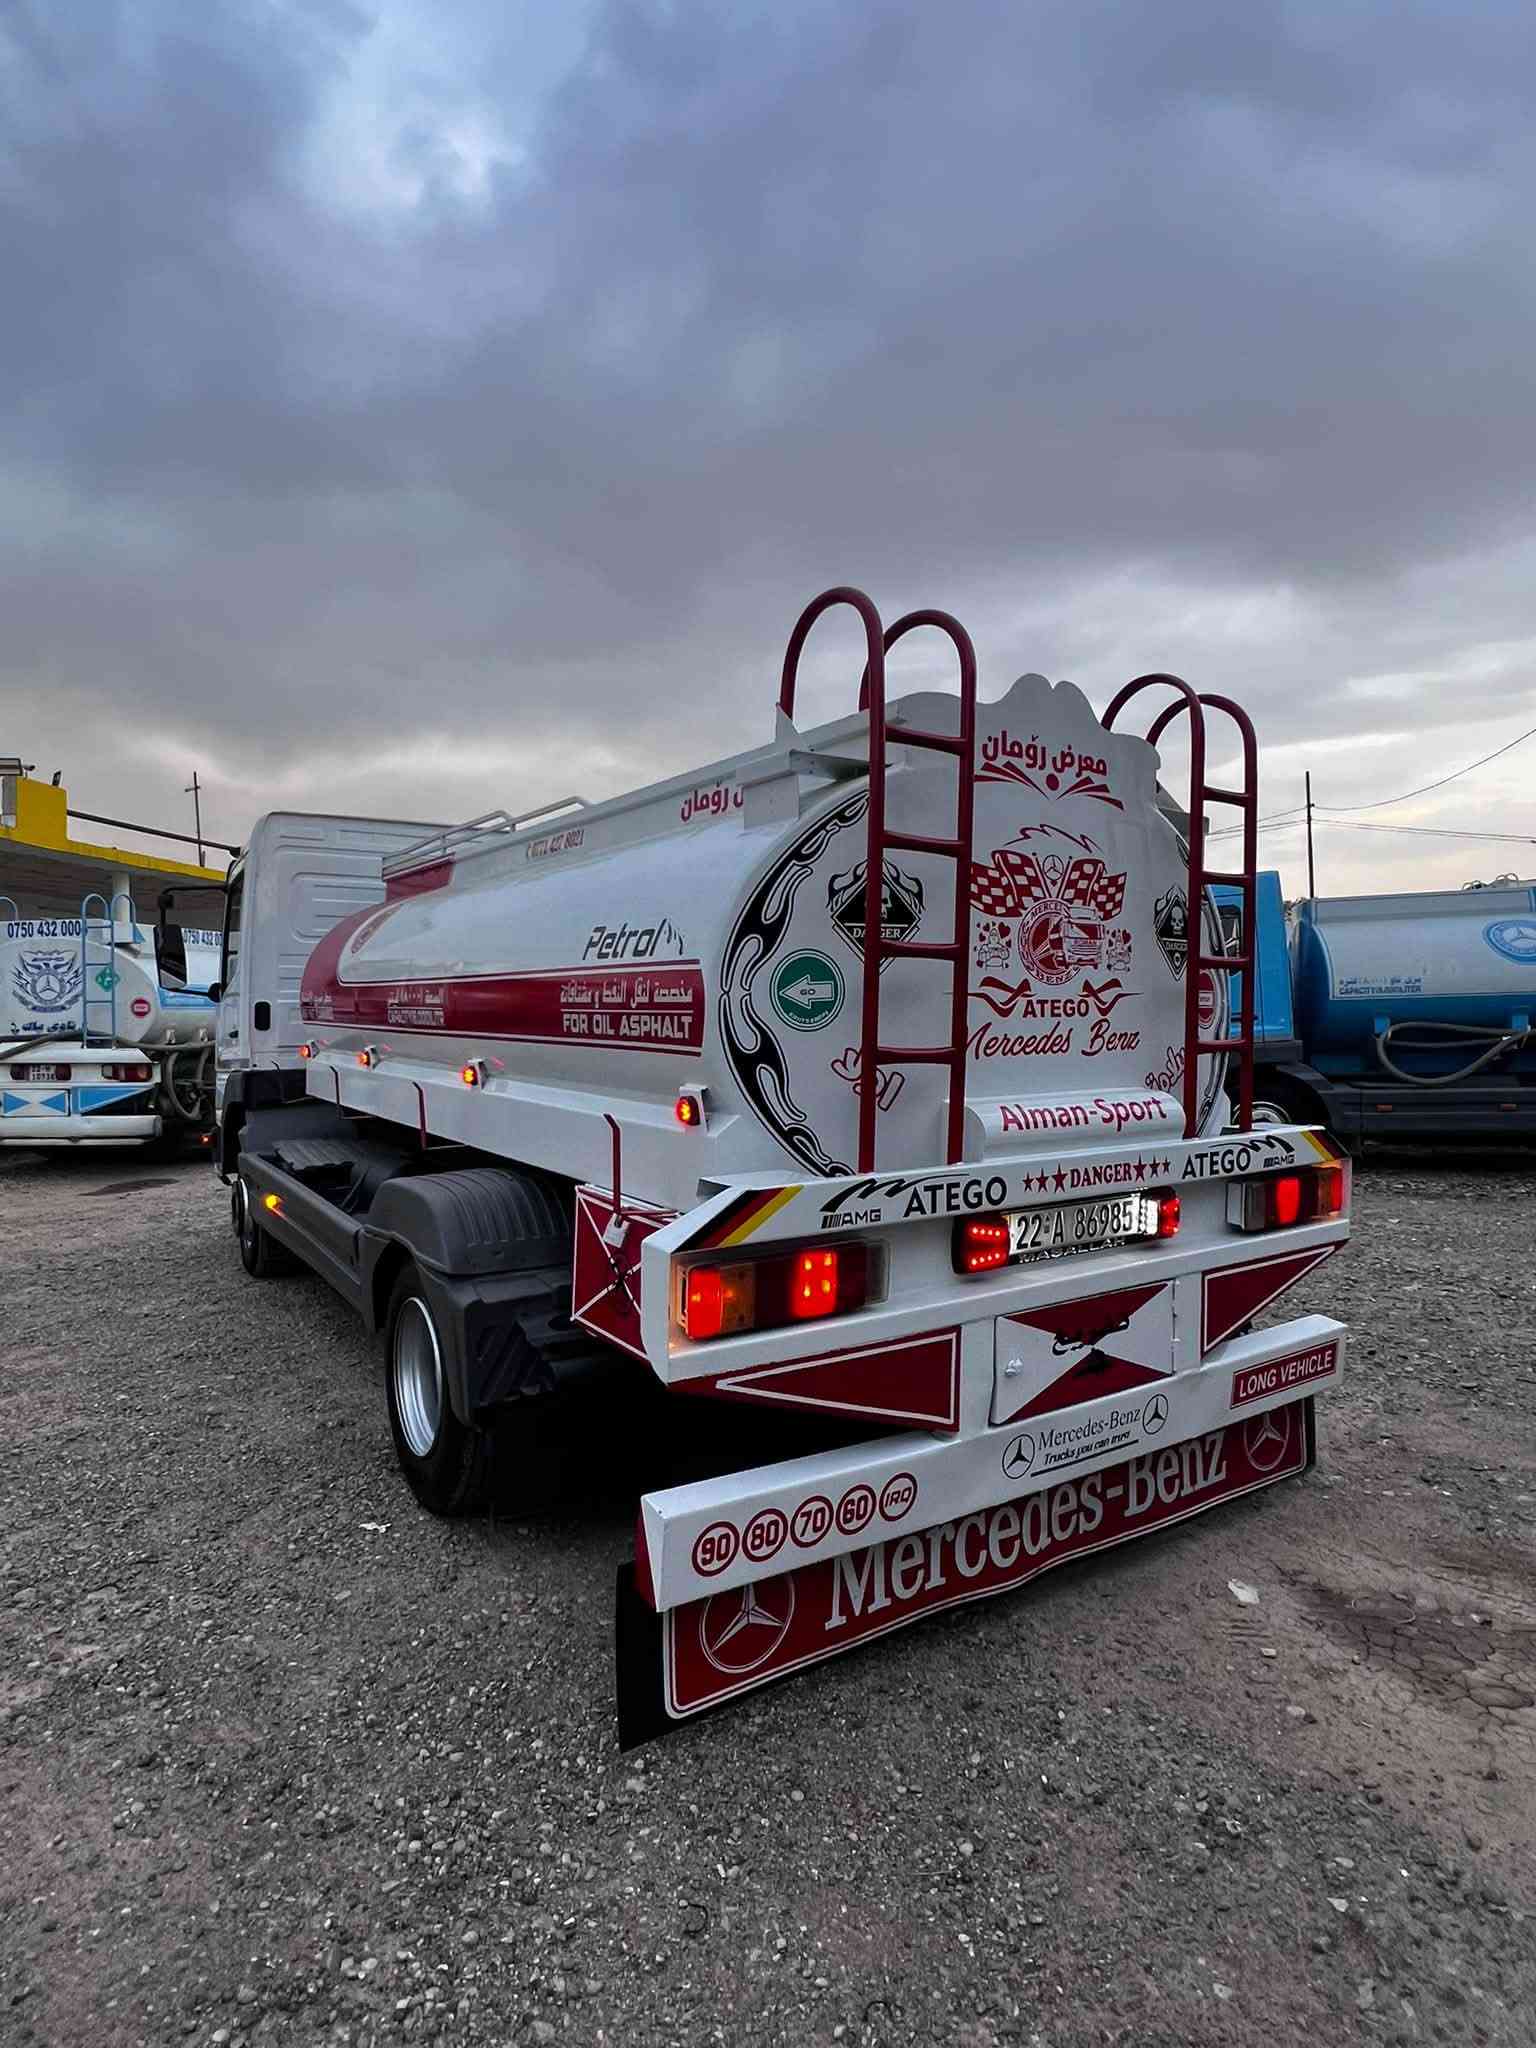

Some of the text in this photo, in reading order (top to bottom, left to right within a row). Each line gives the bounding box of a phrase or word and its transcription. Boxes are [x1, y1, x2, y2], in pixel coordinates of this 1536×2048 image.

[1051, 744, 1107, 778] معرض
[7, 921, 34, 938] 0750
[37, 921, 58, 937] 432
[582, 918, 667, 961] Petrol
[852, 926, 901, 939] DGER
[799, 988, 817, 996] GO
[1022, 999, 1090, 1018] ATEGO
[563, 1013, 693, 1039] FOR OIL ASPHALT
[1081, 1018, 1141, 1057] Benz
[999, 1096, 1168, 1133] Alman-Sport
[1070, 1163, 1132, 1189] DANGER
[1181, 1147, 1296, 1180] ATEGO AMG
[840, 1176, 1008, 1226] AMG ATEGO
[1016, 1213, 1042, 1250] 22
[1051, 1210, 1064, 1245] A
[1074, 1199, 1134, 1241] 86985
[1239, 1350, 1333, 1398] LONG VEHICLE
[1038, 1407, 1141, 1451] Mercedes-Benz
[1043, 1430, 1131, 1465] Trucks you can trust
[799, 1507, 826, 1538] 70
[843, 1494, 868, 1526] 60
[700, 1533, 731, 1566] 90
[750, 1519, 780, 1551] 80
